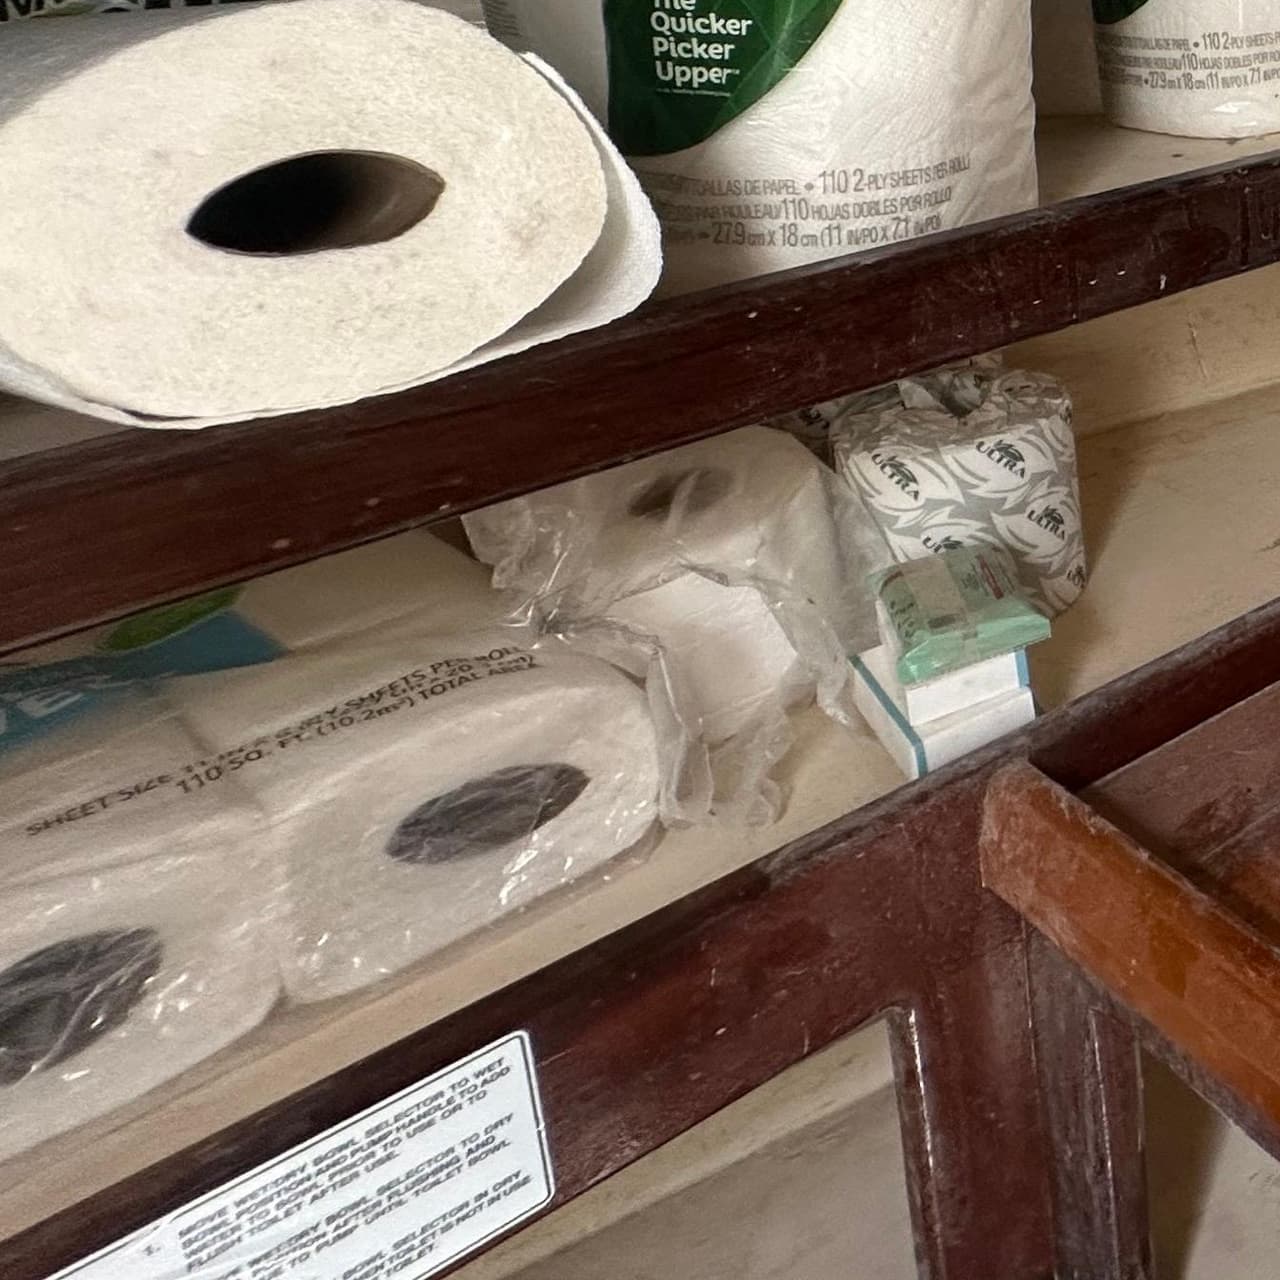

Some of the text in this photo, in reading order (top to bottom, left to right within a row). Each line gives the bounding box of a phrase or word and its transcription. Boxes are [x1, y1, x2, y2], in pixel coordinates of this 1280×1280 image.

[650, 11, 752, 35] Quicker
[652, 36, 735, 60] Picker
[655, 60, 732, 88] Upper
[811, 202, 851, 221] HOJAS
[853, 197, 899, 219] DOBLES
[923, 185, 952, 208] ROLLO
[818, 169, 848, 195] 110
[853, 168, 887, 193] 2-PLY
[889, 168, 932, 189] SHEETS
[779, 223, 798, 247] 18
[801, 233, 818, 247] cm
[871, 453, 921, 502] ULTRA
[976, 440, 1026, 479] ULTRA
[1026, 509, 1066, 542] ULTRA
[176, 765, 222, 794] 110
[418, 671, 484, 701] TOTAL
[25, 797, 110, 836] SHEET
[117, 774, 173, 801] SIZE
[179, 1205, 231, 1239] MOVE
[313, 1136, 359, 1167] BOWL
[365, 1090, 445, 1139] SELECTOR
[449, 1077, 470, 1093] TO
[473, 1057, 505, 1079] WET
[182, 1066, 512, 1250] BOWL POSITION AND PUMP HANDLE TO ADD
[248, 1208, 271, 1225] TO
[275, 1180, 324, 1212] BOWL
[327, 1150, 377, 1182] PRIOR
[381, 1136, 403, 1152] TO
[405, 1119, 438, 1140] USE
[440, 1104, 463, 1121] OR
[466, 1089, 488, 1106] TO
[325, 1196, 374, 1227] BOWL
[376, 1145, 456, 1197] SELECTOR
[459, 1131, 481, 1148] TO
[484, 1112, 514, 1136] DRY
[332, 1198, 383, 1234] AFTER
[386, 1154, 461, 1203] FLUSHING
[465, 1134, 497, 1159] AND
[186, 1234, 243, 1274] FLUSH
[247, 1200, 304, 1237] TOILET
[309, 1170, 361, 1205] AFTER
[289, 1140, 513, 1268] TO PUMP UNTIL TOILET BOWL
[343, 1169, 522, 1280] BOWL SELECTOR IN DRY
[387, 1229, 438, 1264] TOILET
[455, 1201, 485, 1226] NOT
[487, 1193, 502, 1208] IN
[503, 1174, 533, 1197] USE
